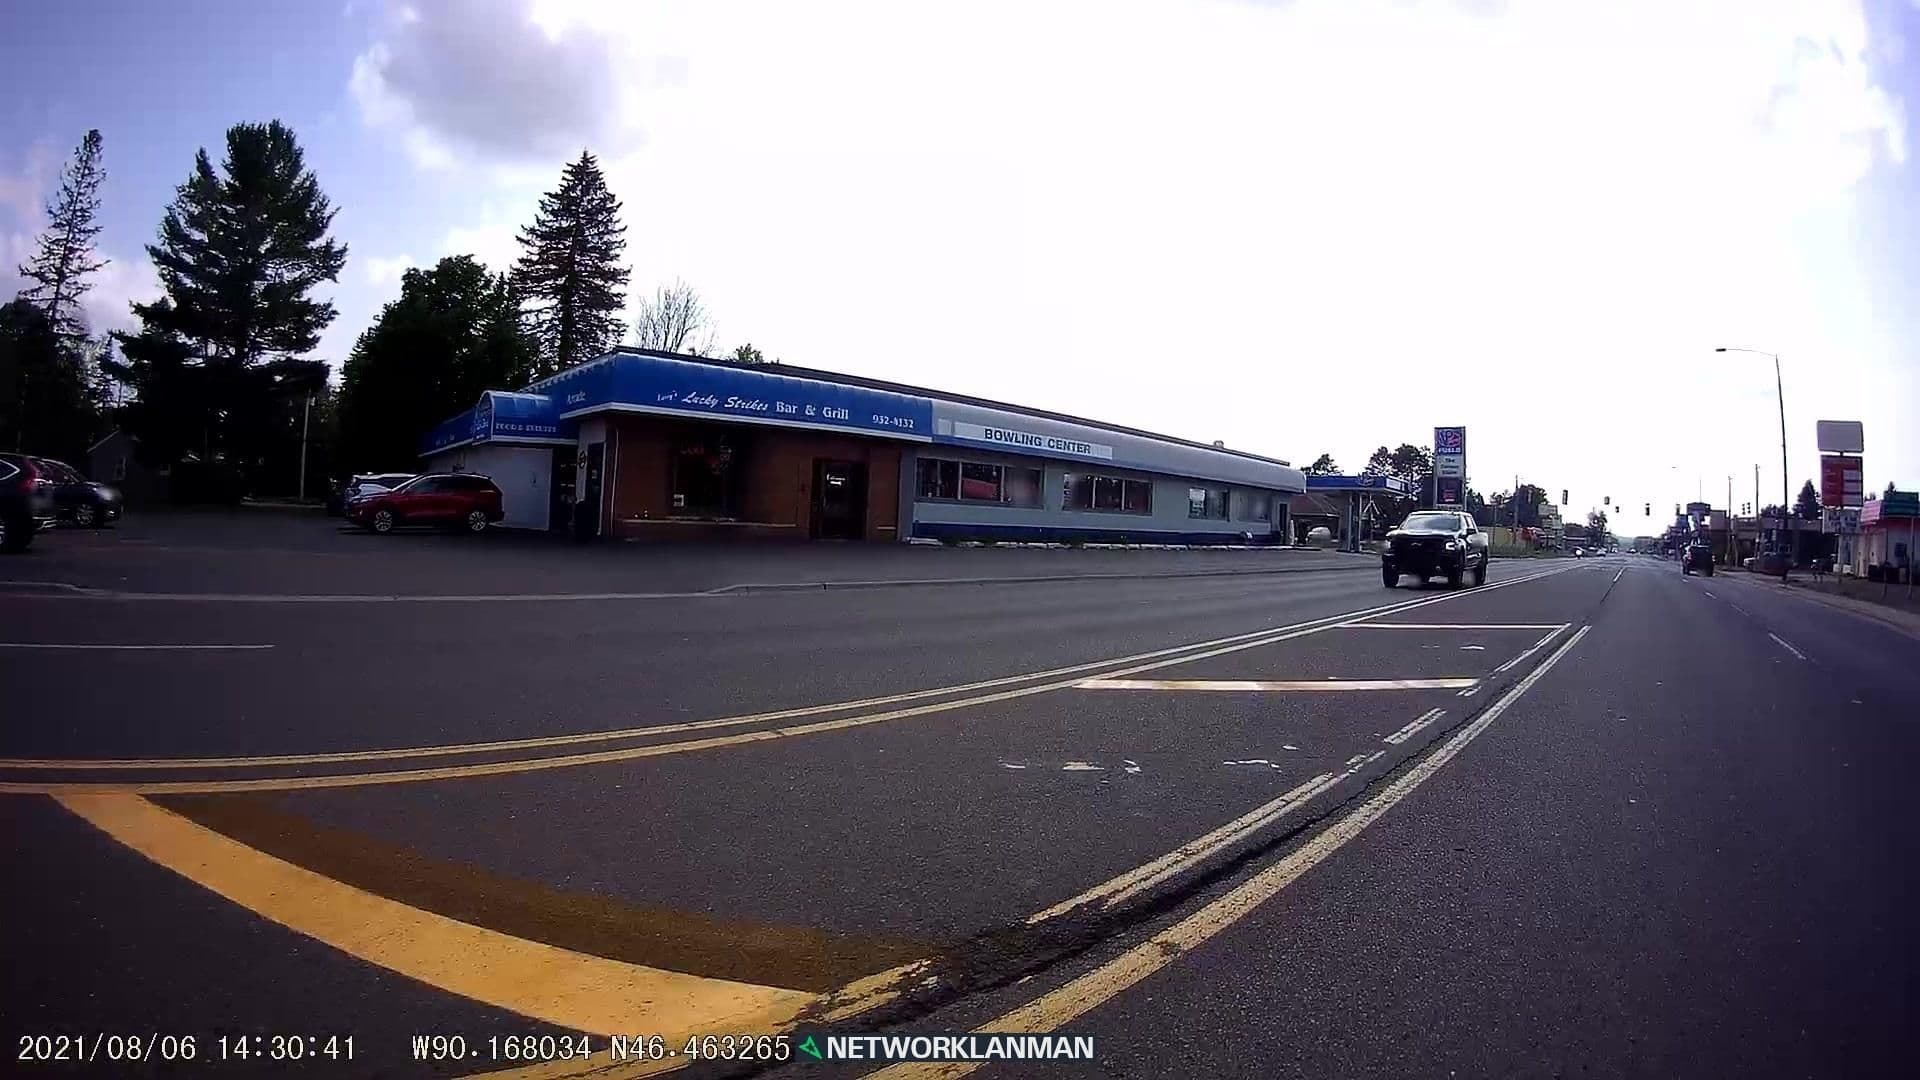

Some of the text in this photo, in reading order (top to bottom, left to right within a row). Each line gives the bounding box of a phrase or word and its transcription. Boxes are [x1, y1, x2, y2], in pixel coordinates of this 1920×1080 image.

[681, 391, 719, 408] Lucky
[723, 396, 769, 411] Strikes
[775, 401, 798, 414] Bar
[804, 404, 817, 416] &
[822, 407, 849, 420] Grill
[984, 428, 1091, 454] BOWLING CENTER
